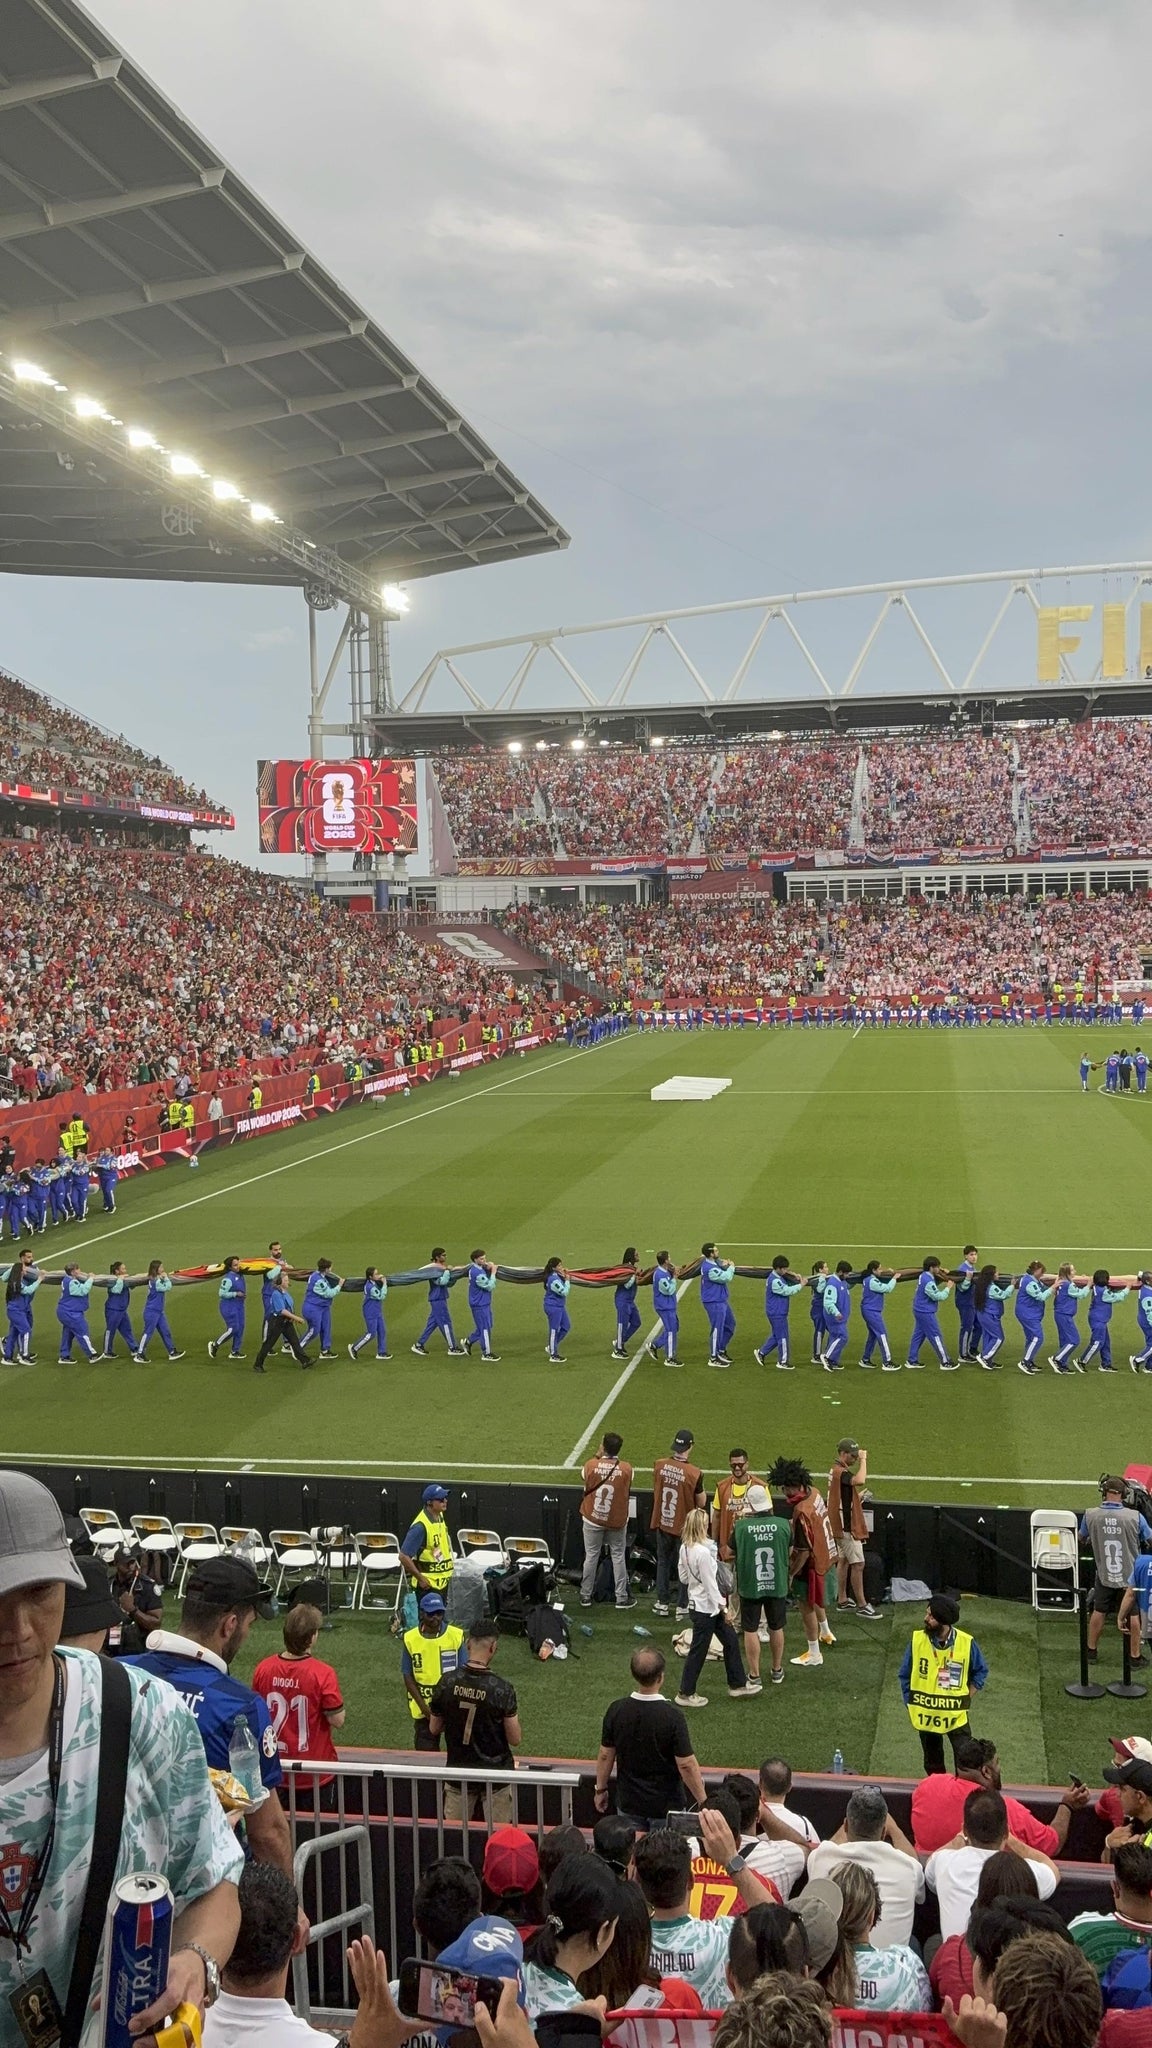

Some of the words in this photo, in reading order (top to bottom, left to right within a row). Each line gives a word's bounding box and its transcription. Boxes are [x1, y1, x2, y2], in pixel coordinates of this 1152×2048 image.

[671, 893, 689, 901] FIFA
[690, 892, 720, 900] WORLD
[237, 1119, 250, 1133] FIFA
[250, 1113, 271, 1130] WORLD
[271, 1110, 282, 1124] CUP
[282, 1104, 301, 1121] 2026
[117, 1151, 139, 1169] 026
[664, 1464, 684, 1474] MEDIA
[660, 1469, 686, 1482] PARTNER
[664, 1478, 678, 1486] 3754
[1105, 1518, 1117, 1526] HB
[748, 1524, 777, 1533] PHOTO
[1102, 1526, 1122, 1534] 1039
[753, 1533, 774, 1541] 1465
[272, 1677, 293, 1688] DIOGO
[419, 1687, 433, 1697] ECU
[453, 1685, 487, 1701] RONALDO
[176, 1691, 205, 1718] IĆ
[913, 1693, 962, 1709] SECURITY
[266, 1691, 309, 1753] 21
[459, 1701, 477, 1745] 7
[691, 1857, 729, 1877] RONA
